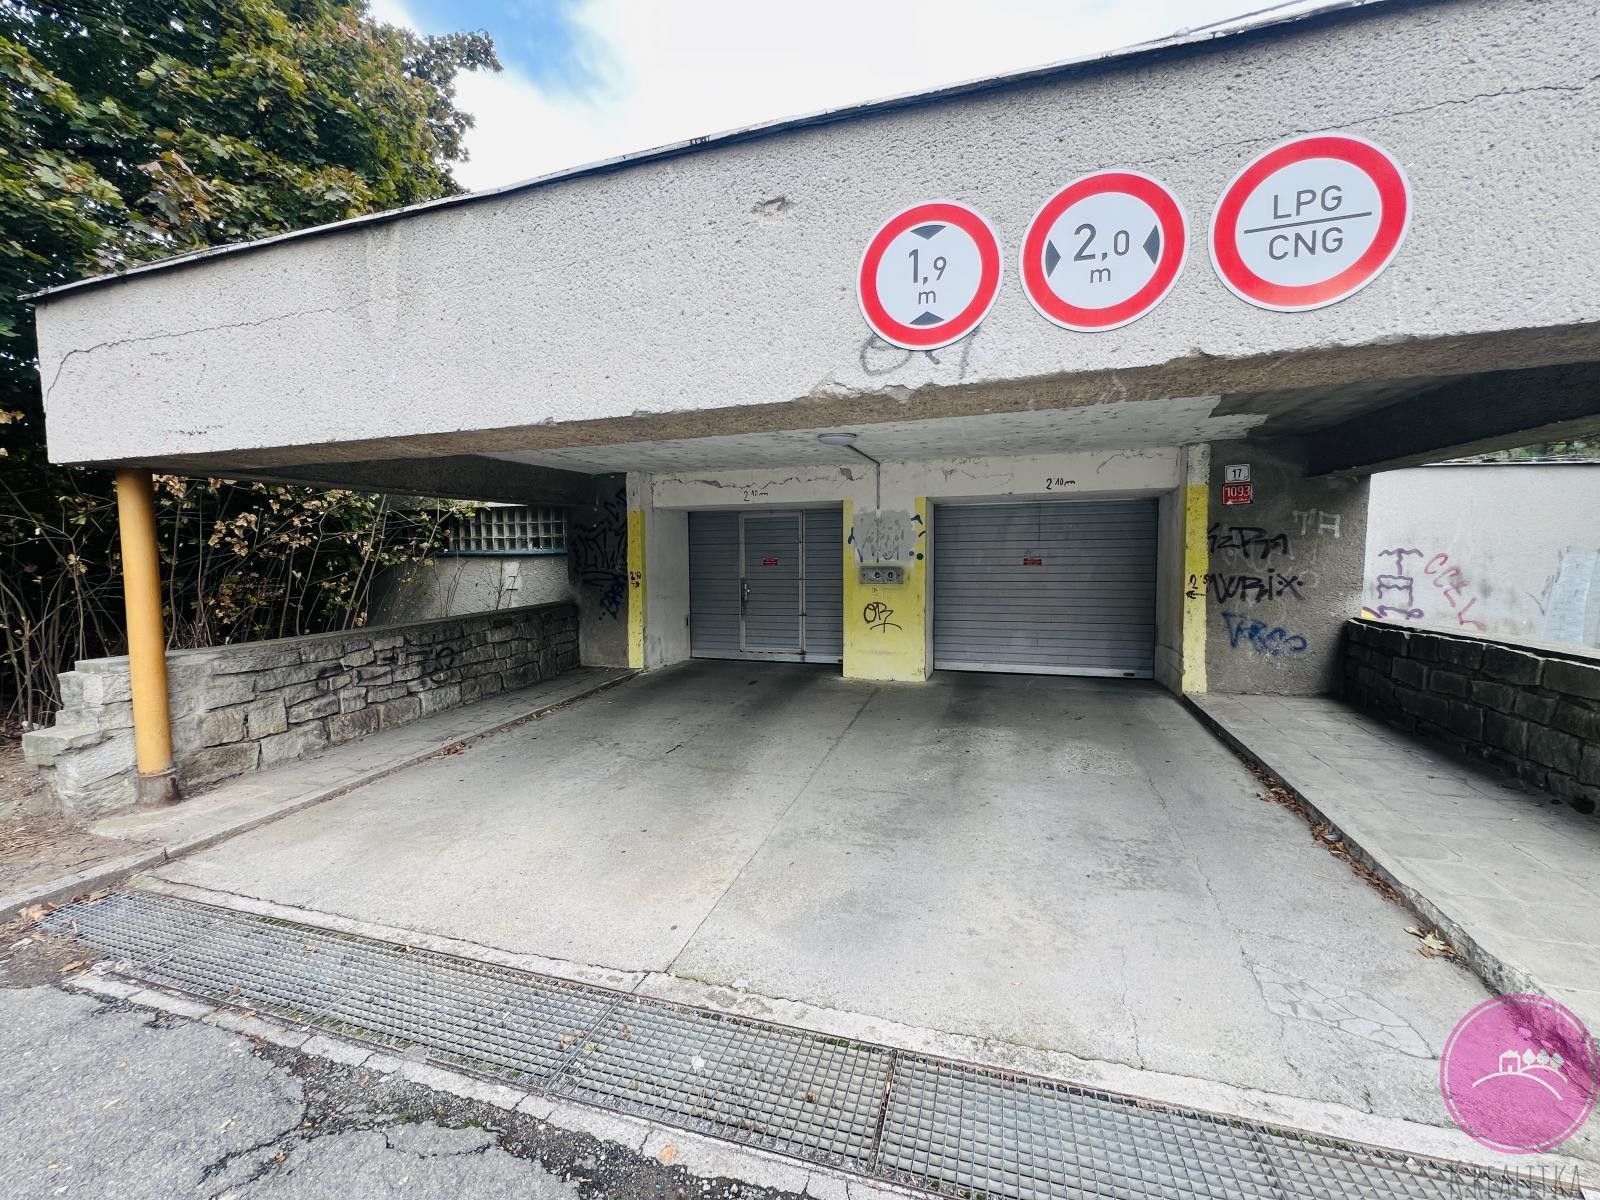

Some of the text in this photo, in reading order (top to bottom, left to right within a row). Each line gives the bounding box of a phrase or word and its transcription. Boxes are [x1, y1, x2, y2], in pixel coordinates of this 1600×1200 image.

[1271, 184, 1344, 220] LPG
[1072, 222, 1130, 263] 2,0
[1267, 226, 1345, 262] CNG
[908, 248, 948, 287] 1,9
[1088, 264, 1112, 284] m
[917, 289, 937, 305] m
[1231, 468, 1242, 479] 17
[1224, 485, 1251, 498] 1093
